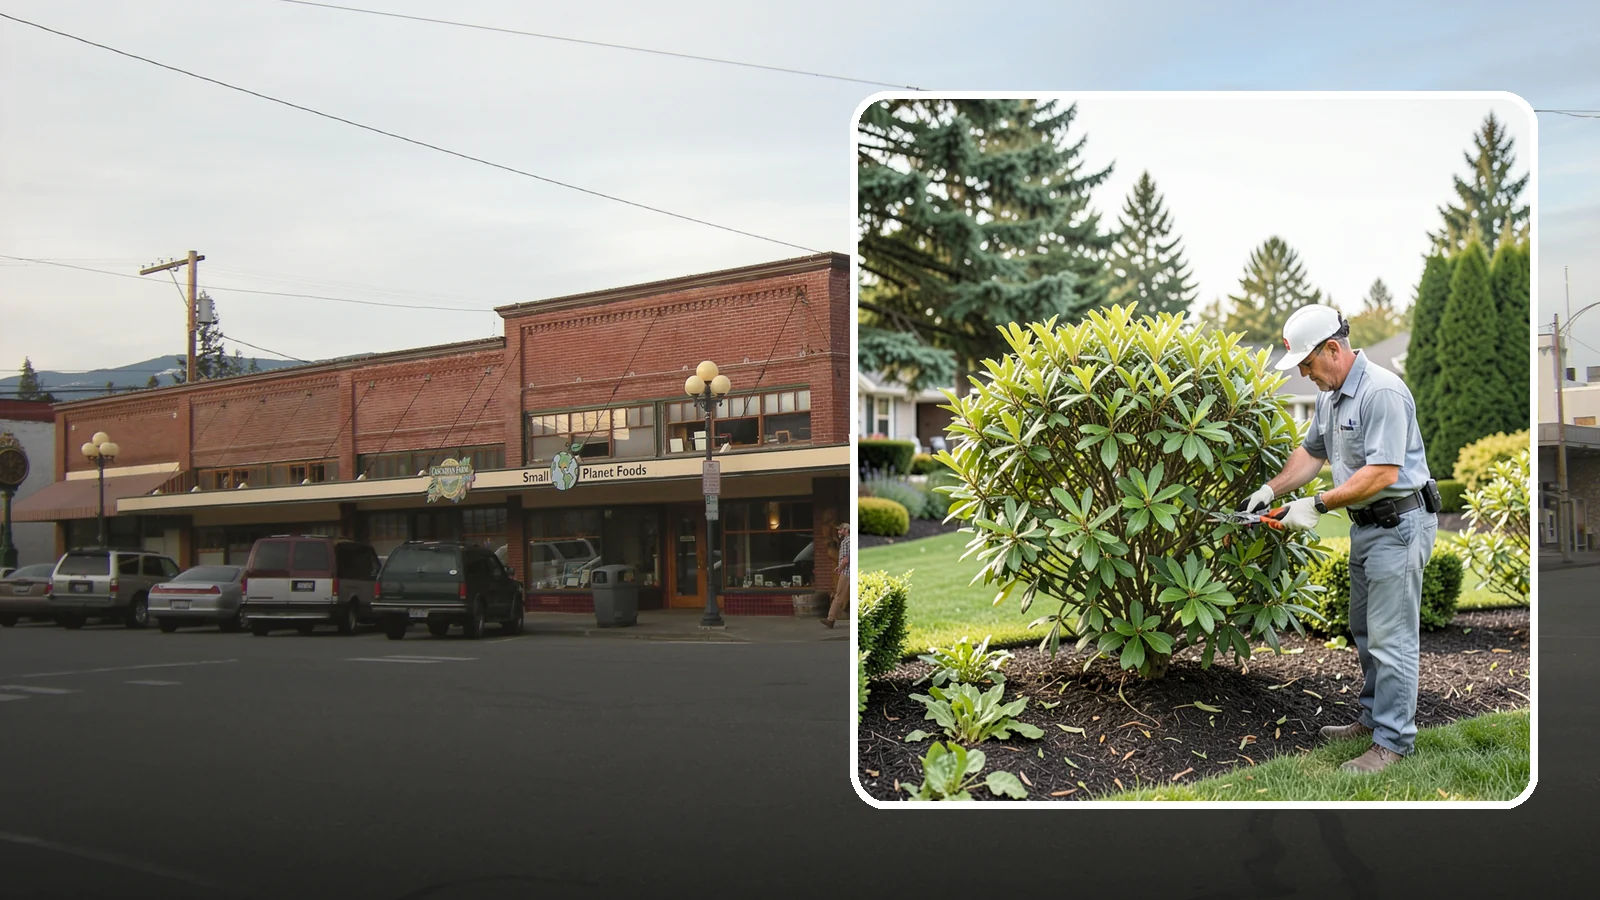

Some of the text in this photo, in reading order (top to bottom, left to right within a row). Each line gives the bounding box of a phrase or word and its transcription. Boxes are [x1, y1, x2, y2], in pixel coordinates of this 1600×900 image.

[523, 464, 646, 482] Small Planet Foods
